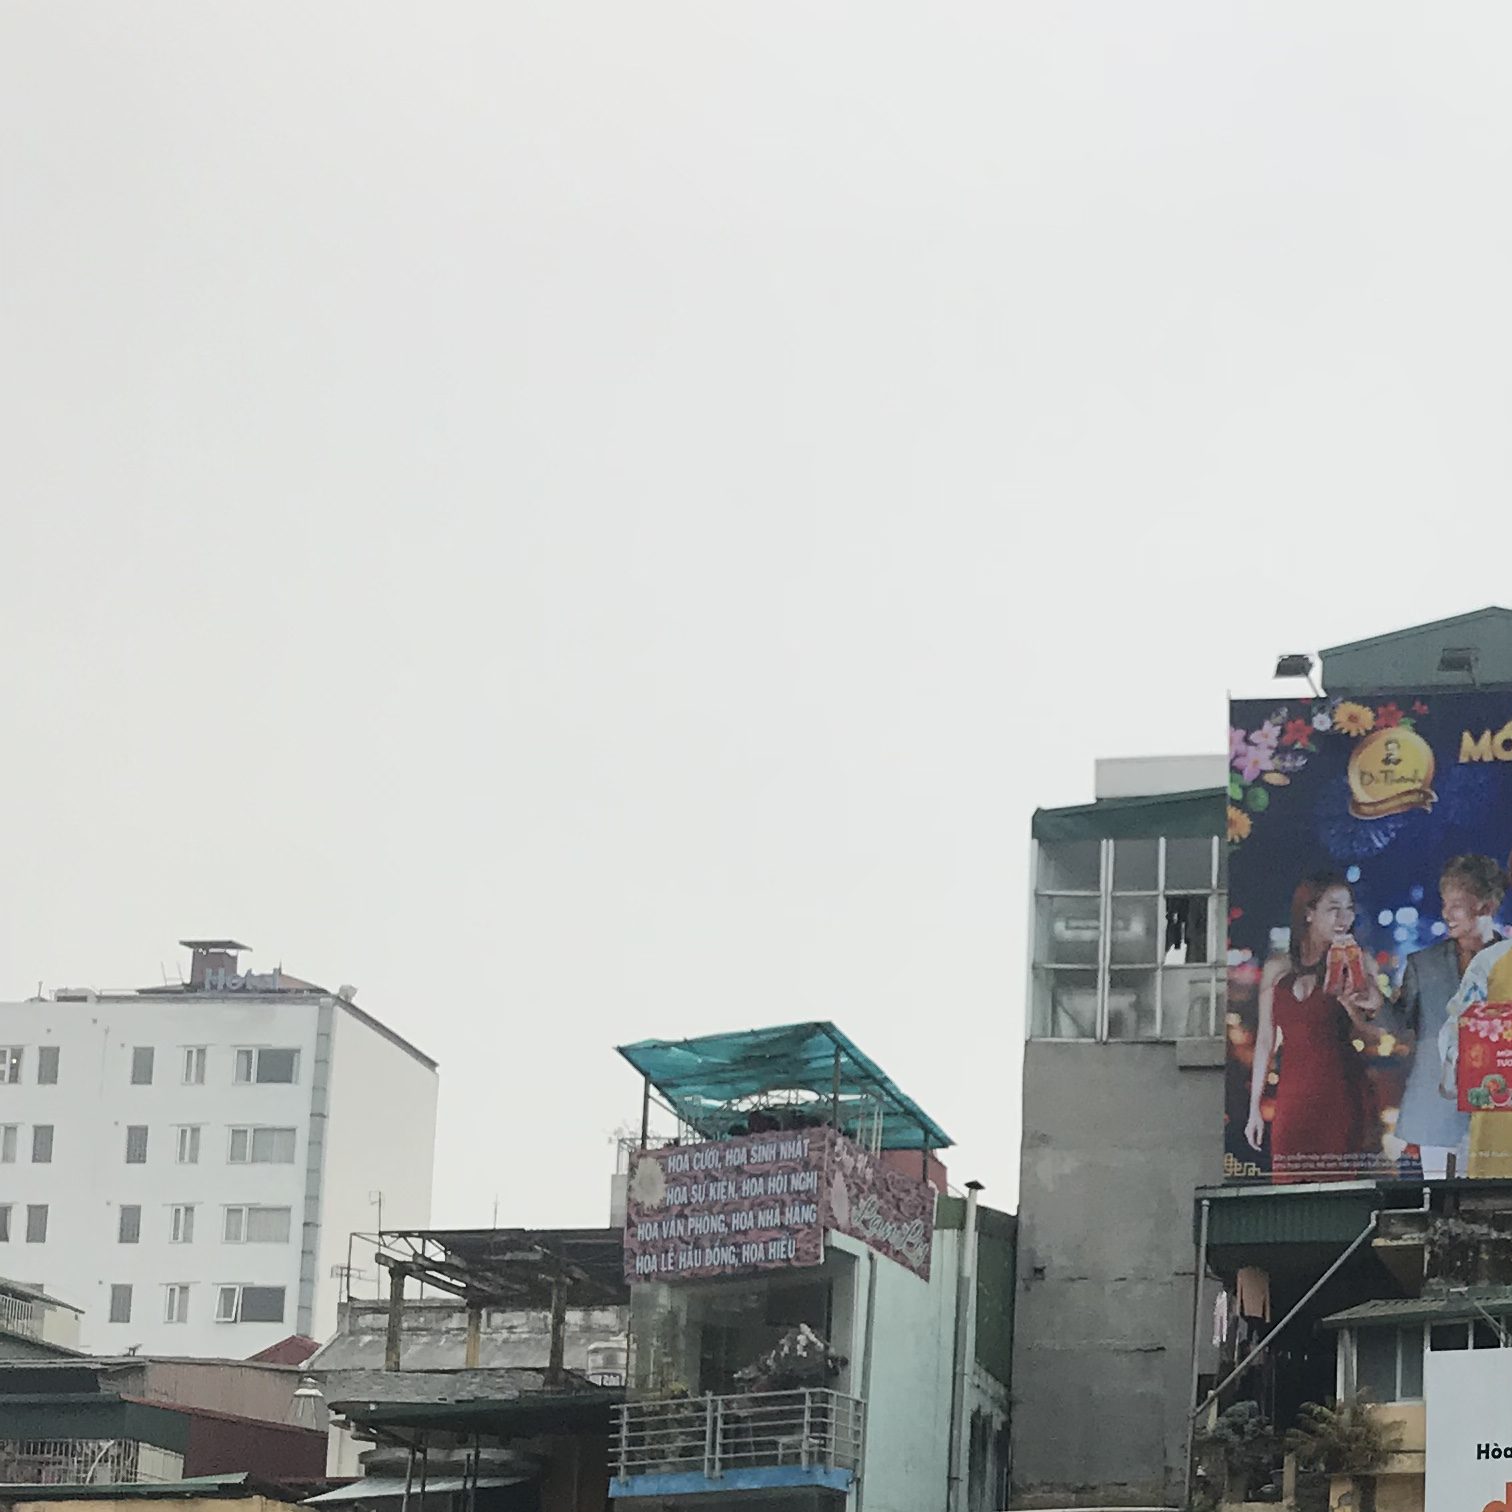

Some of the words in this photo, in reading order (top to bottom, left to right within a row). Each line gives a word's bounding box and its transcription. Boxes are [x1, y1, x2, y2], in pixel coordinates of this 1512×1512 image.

[668, 1153, 690, 1173] HOA
[725, 1147, 748, 1167] HOA
[750, 1143, 777, 1164] SINH
[666, 1187, 688, 1206] HOA
[741, 1177, 764, 1197] HOA
[637, 1222, 659, 1241] HOA
[731, 1211, 755, 1232] HOA
[758, 1202, 781, 1229] NHÀ
[635, 1254, 658, 1275] HOA
[742, 1244, 765, 1263] HOA
